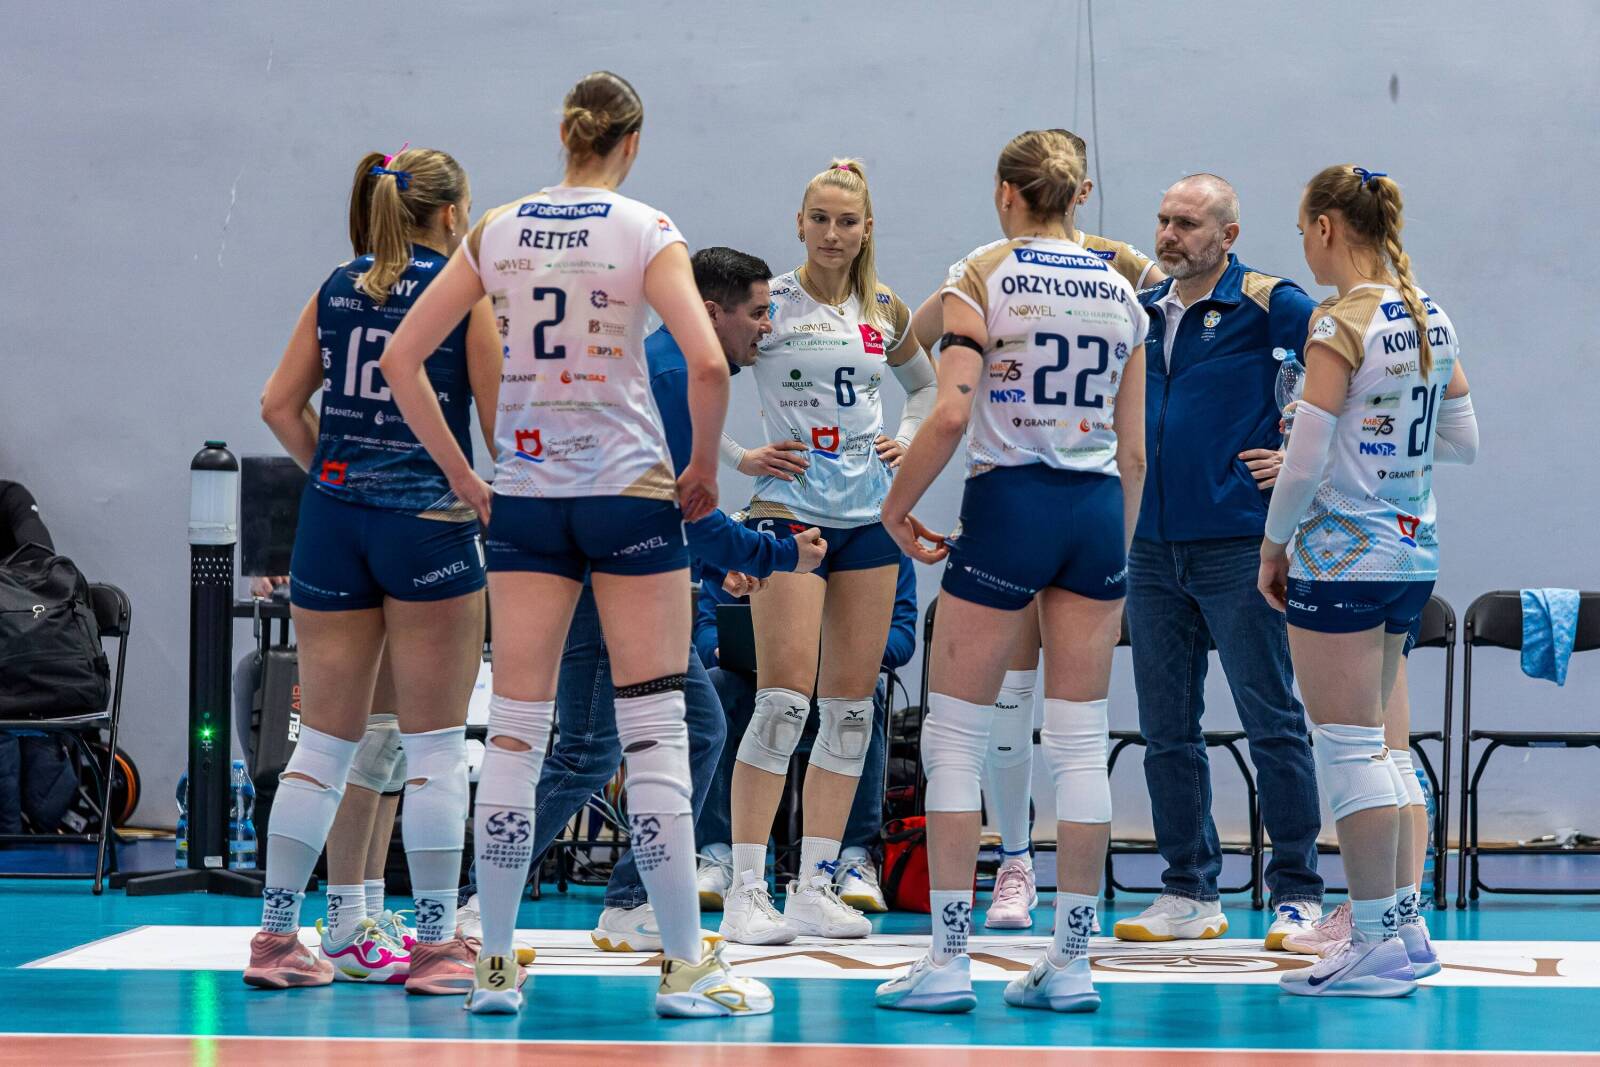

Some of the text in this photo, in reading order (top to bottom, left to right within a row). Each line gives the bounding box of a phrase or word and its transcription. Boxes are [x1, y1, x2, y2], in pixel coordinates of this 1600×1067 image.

[537, 203, 607, 217] DECATHLON
[518, 228, 590, 250] REITER
[1037, 252, 1104, 269] DECATHLON
[1002, 275, 1128, 305] ORZYŁOWSKA
[328, 296, 365, 312] NOWEL
[1008, 304, 1056, 317] NOWEL
[532, 286, 567, 360] 2
[793, 322, 836, 333] NOWEL
[1382, 325, 1453, 355] KOWACZY
[343, 326, 392, 401] 12
[1033, 331, 1109, 409] 22
[1385, 360, 1418, 377] NOWEL
[834, 366, 856, 407] 6
[1363, 418, 1381, 426] MBS
[413, 559, 470, 588] NOWEL
[971, 568, 1029, 594] ECO HARPOON
[288, 712, 301, 742] PELI
